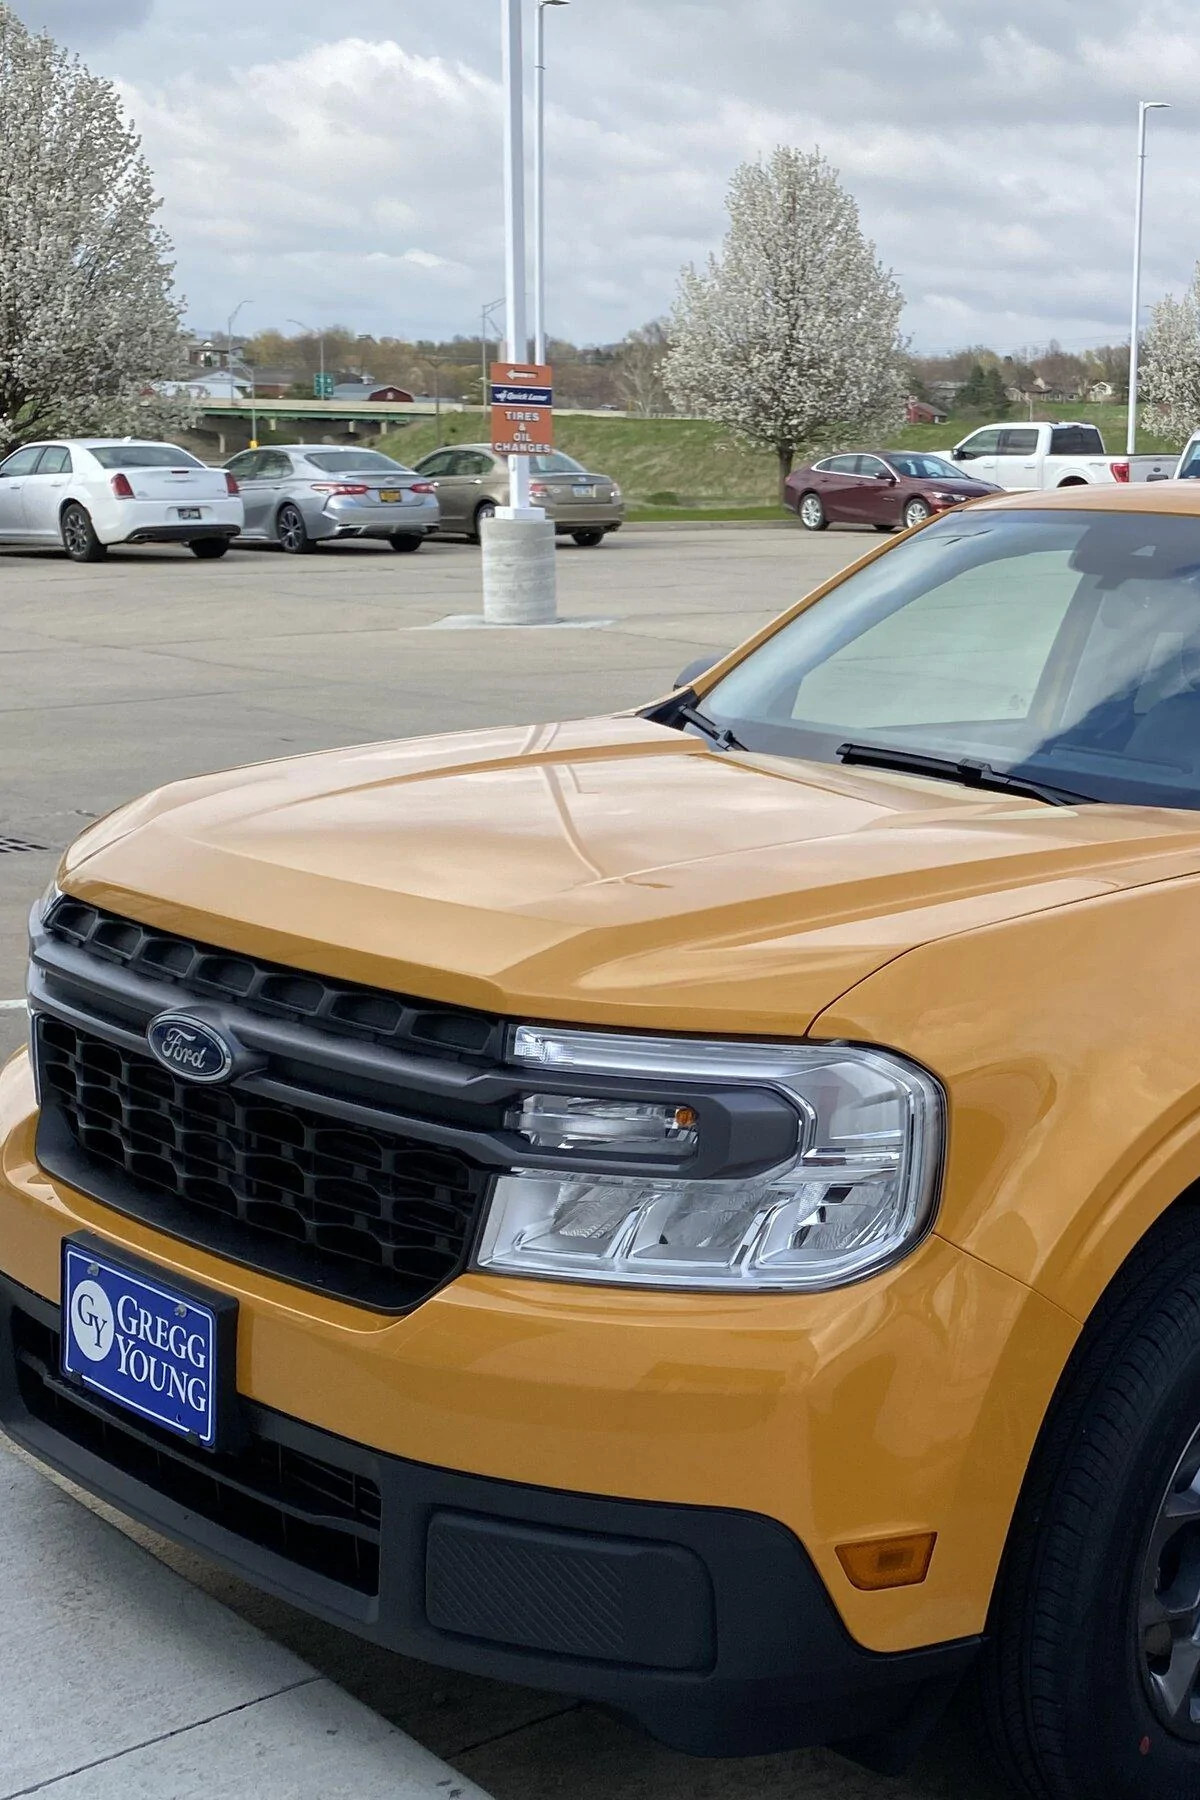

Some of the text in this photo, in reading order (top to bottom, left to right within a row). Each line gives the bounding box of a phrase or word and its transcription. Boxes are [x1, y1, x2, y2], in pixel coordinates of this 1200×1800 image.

[507, 392, 528, 401] Quick
[505, 411, 540, 421] TIRES
[518, 422, 526, 431] &
[513, 433, 532, 442] OIL
[495, 443, 551, 453] CHANGES
[162, 1027, 207, 1069] Ford
[77, 1293, 108, 1349] GY
[117, 1295, 206, 1369] GREGG
[114, 1332, 207, 1412] YOUNG
